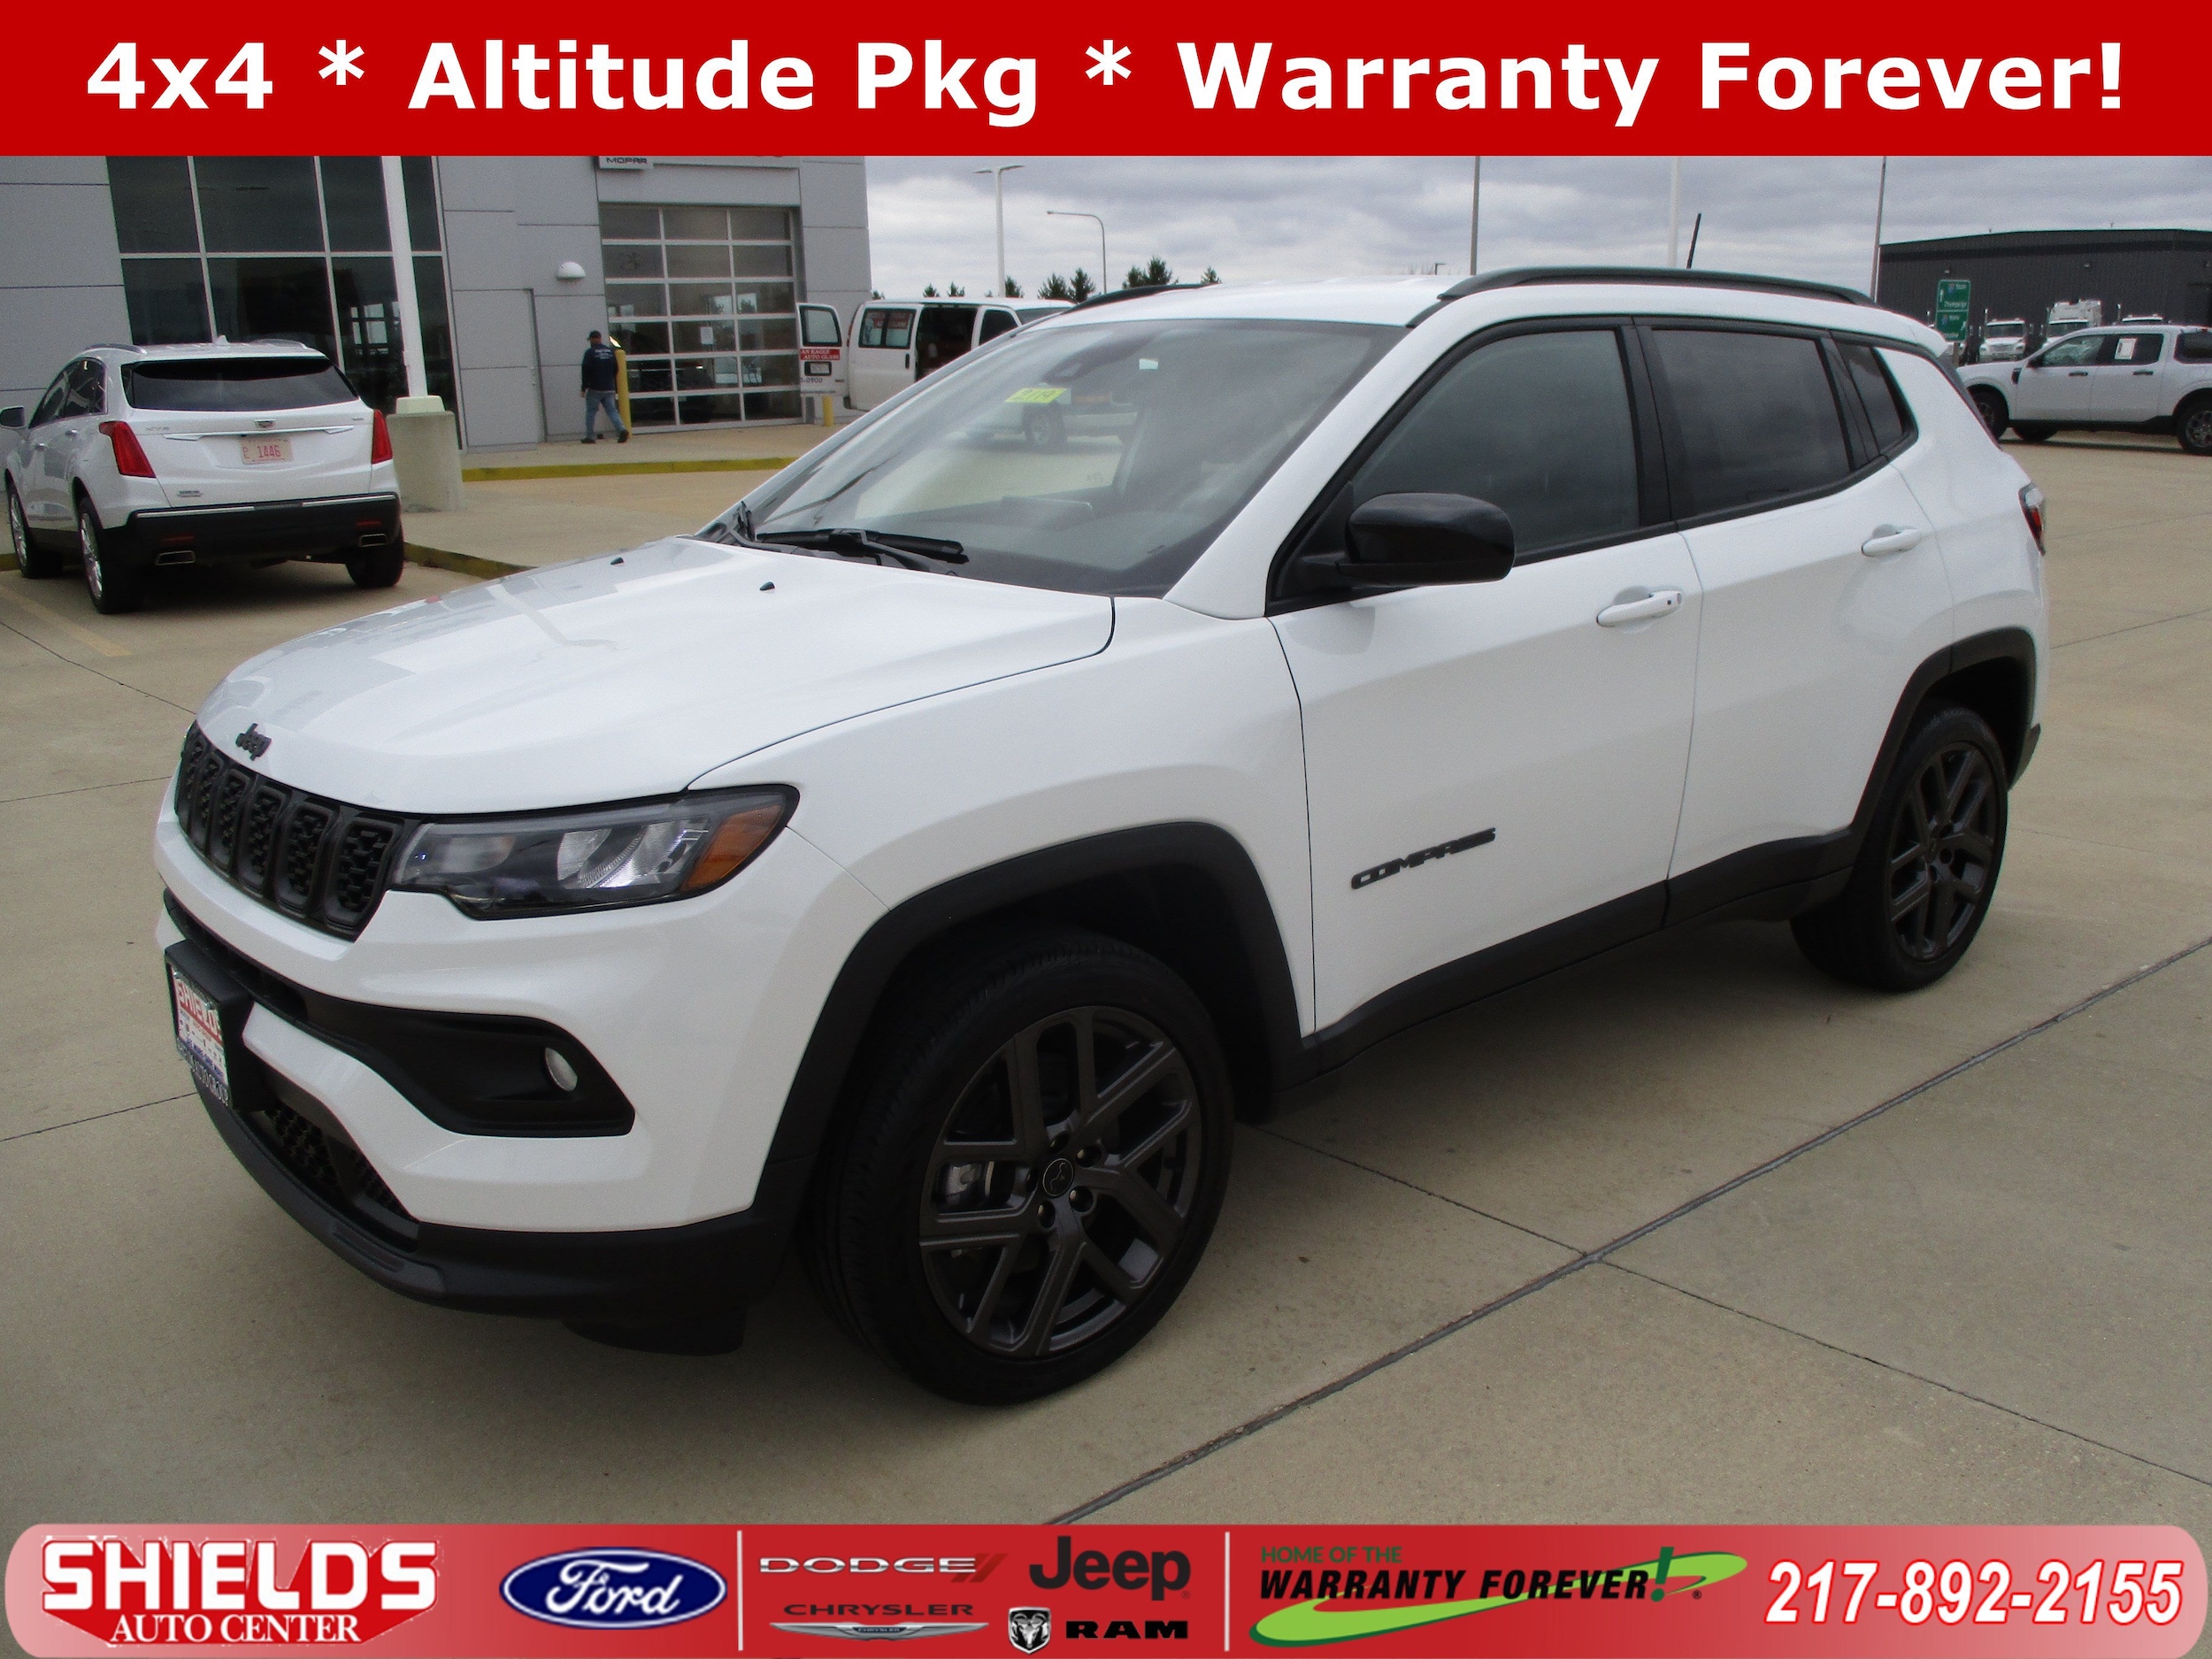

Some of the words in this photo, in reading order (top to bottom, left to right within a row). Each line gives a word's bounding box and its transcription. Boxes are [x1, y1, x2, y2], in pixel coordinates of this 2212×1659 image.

[605, 156, 648, 165] MOPAR
[257, 444, 281, 458] 1446
[1351, 826, 1496, 889] COMPASS
